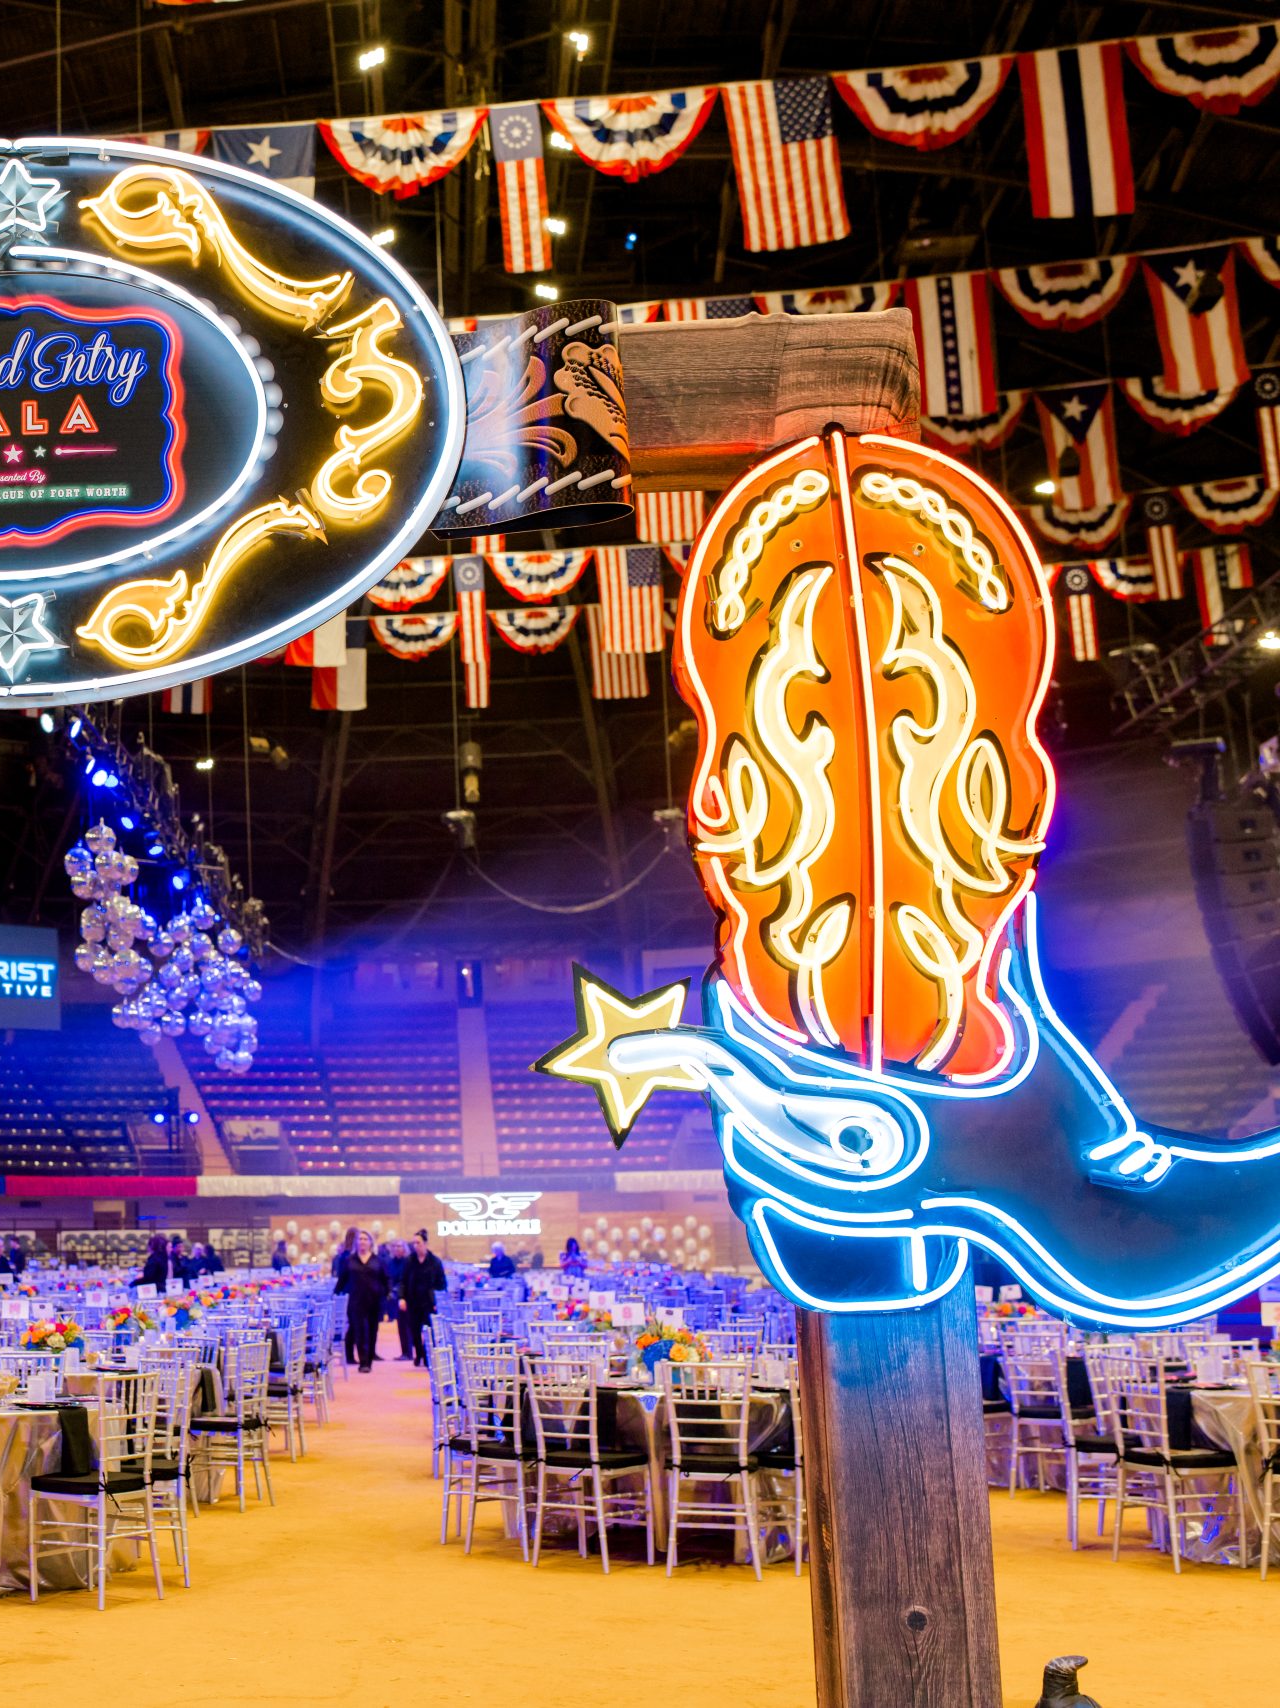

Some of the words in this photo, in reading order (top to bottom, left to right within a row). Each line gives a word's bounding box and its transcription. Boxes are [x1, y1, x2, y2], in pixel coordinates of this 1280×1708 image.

[31, 331, 146, 405] Entry
[29, 469, 46, 483] By
[30, 489, 44, 498] OF
[50, 488, 80, 498] FORT
[86, 487, 127, 497] WORTH
